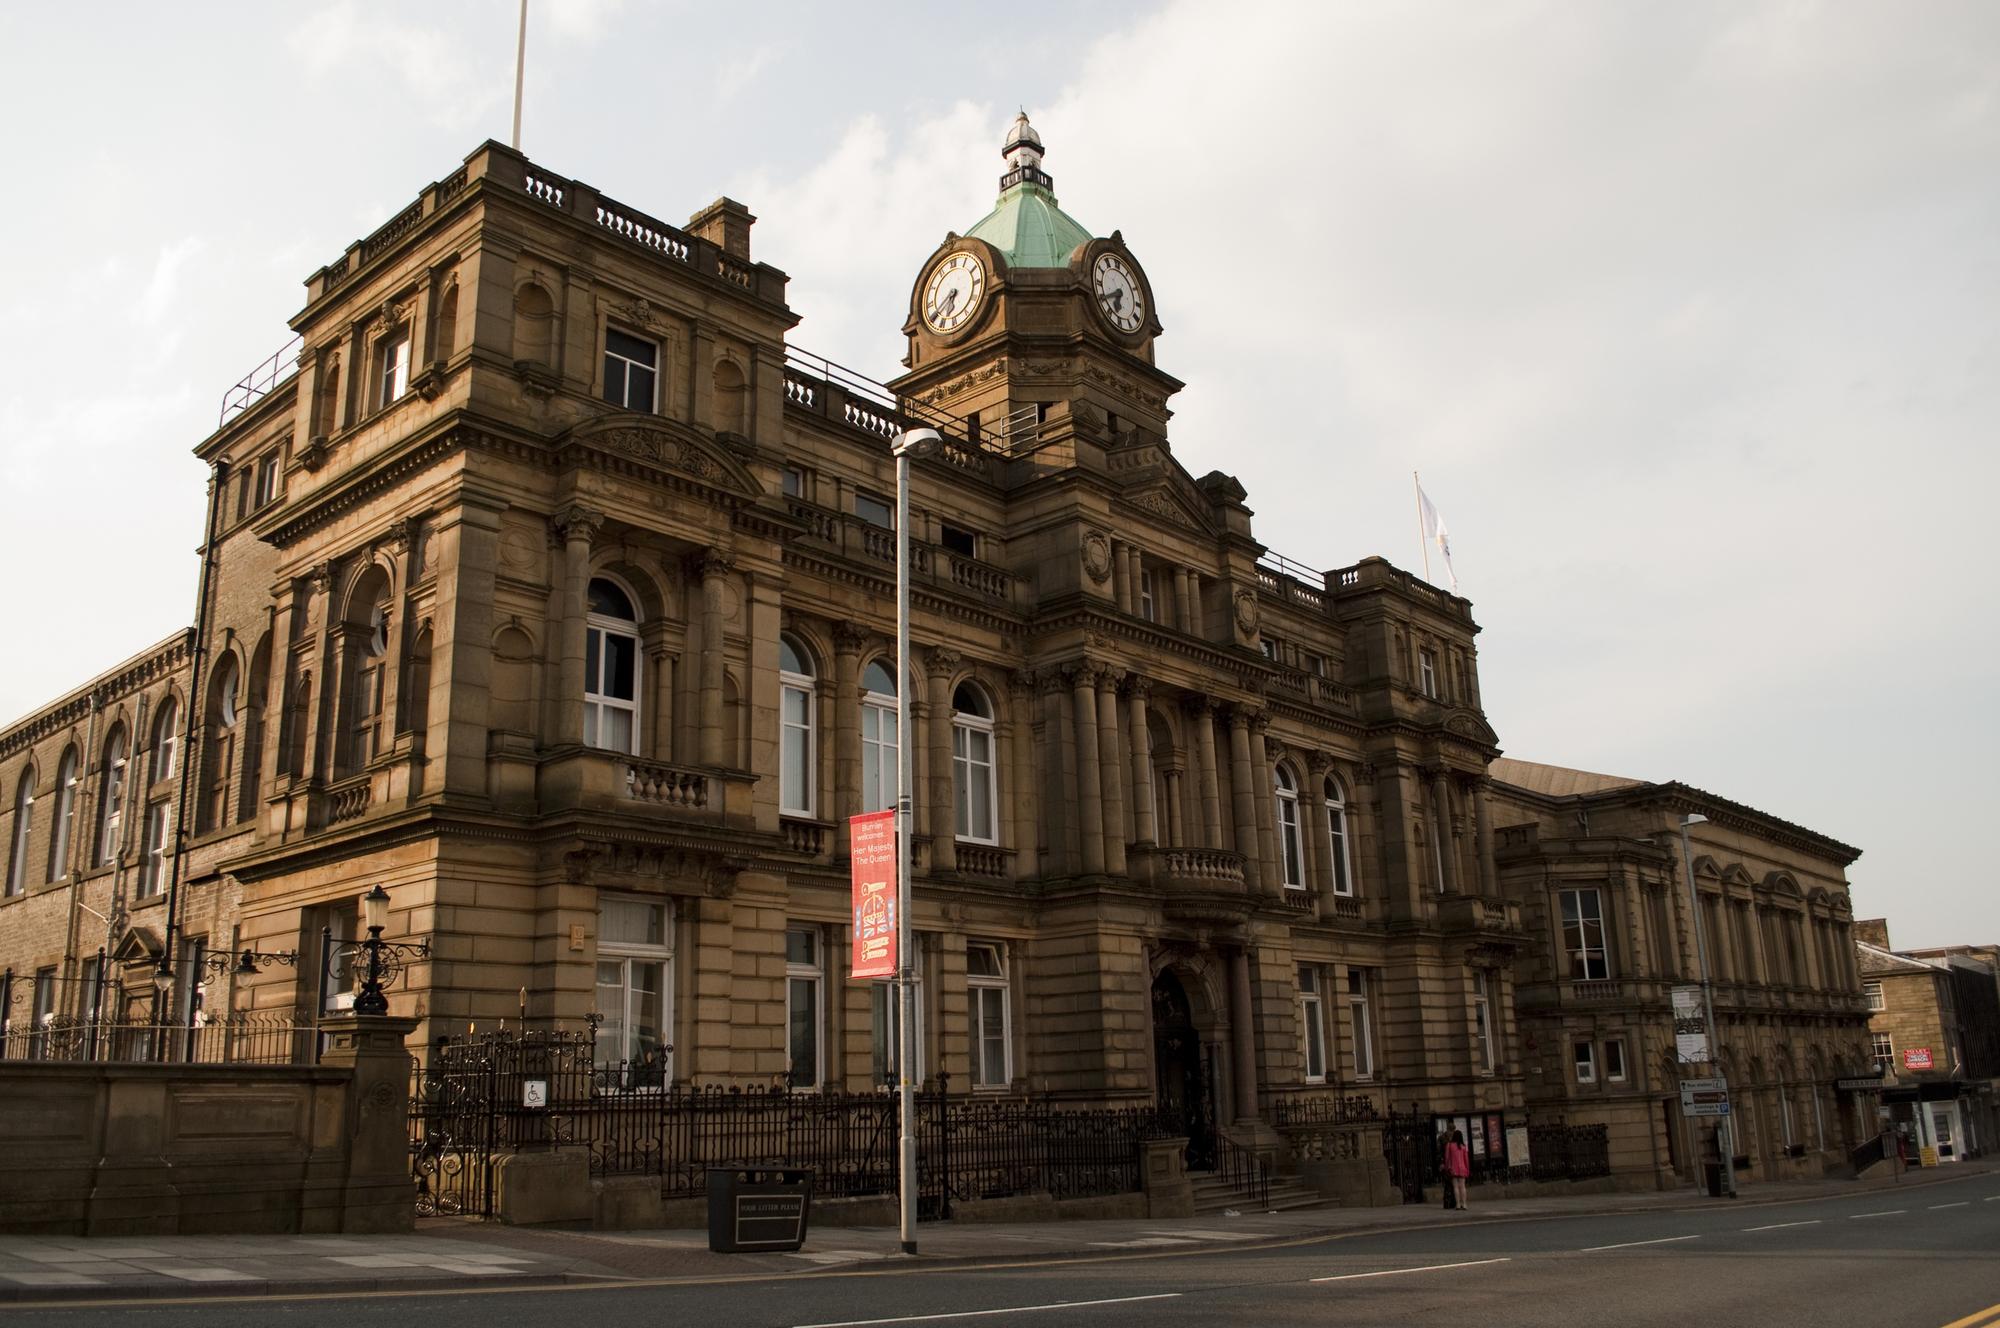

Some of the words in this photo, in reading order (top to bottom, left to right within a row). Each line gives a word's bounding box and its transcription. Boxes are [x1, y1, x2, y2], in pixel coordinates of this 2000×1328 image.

[862, 822, 883, 831] Burnley
[868, 843, 893, 853] Majesty
[870, 855, 891, 864] Queen
